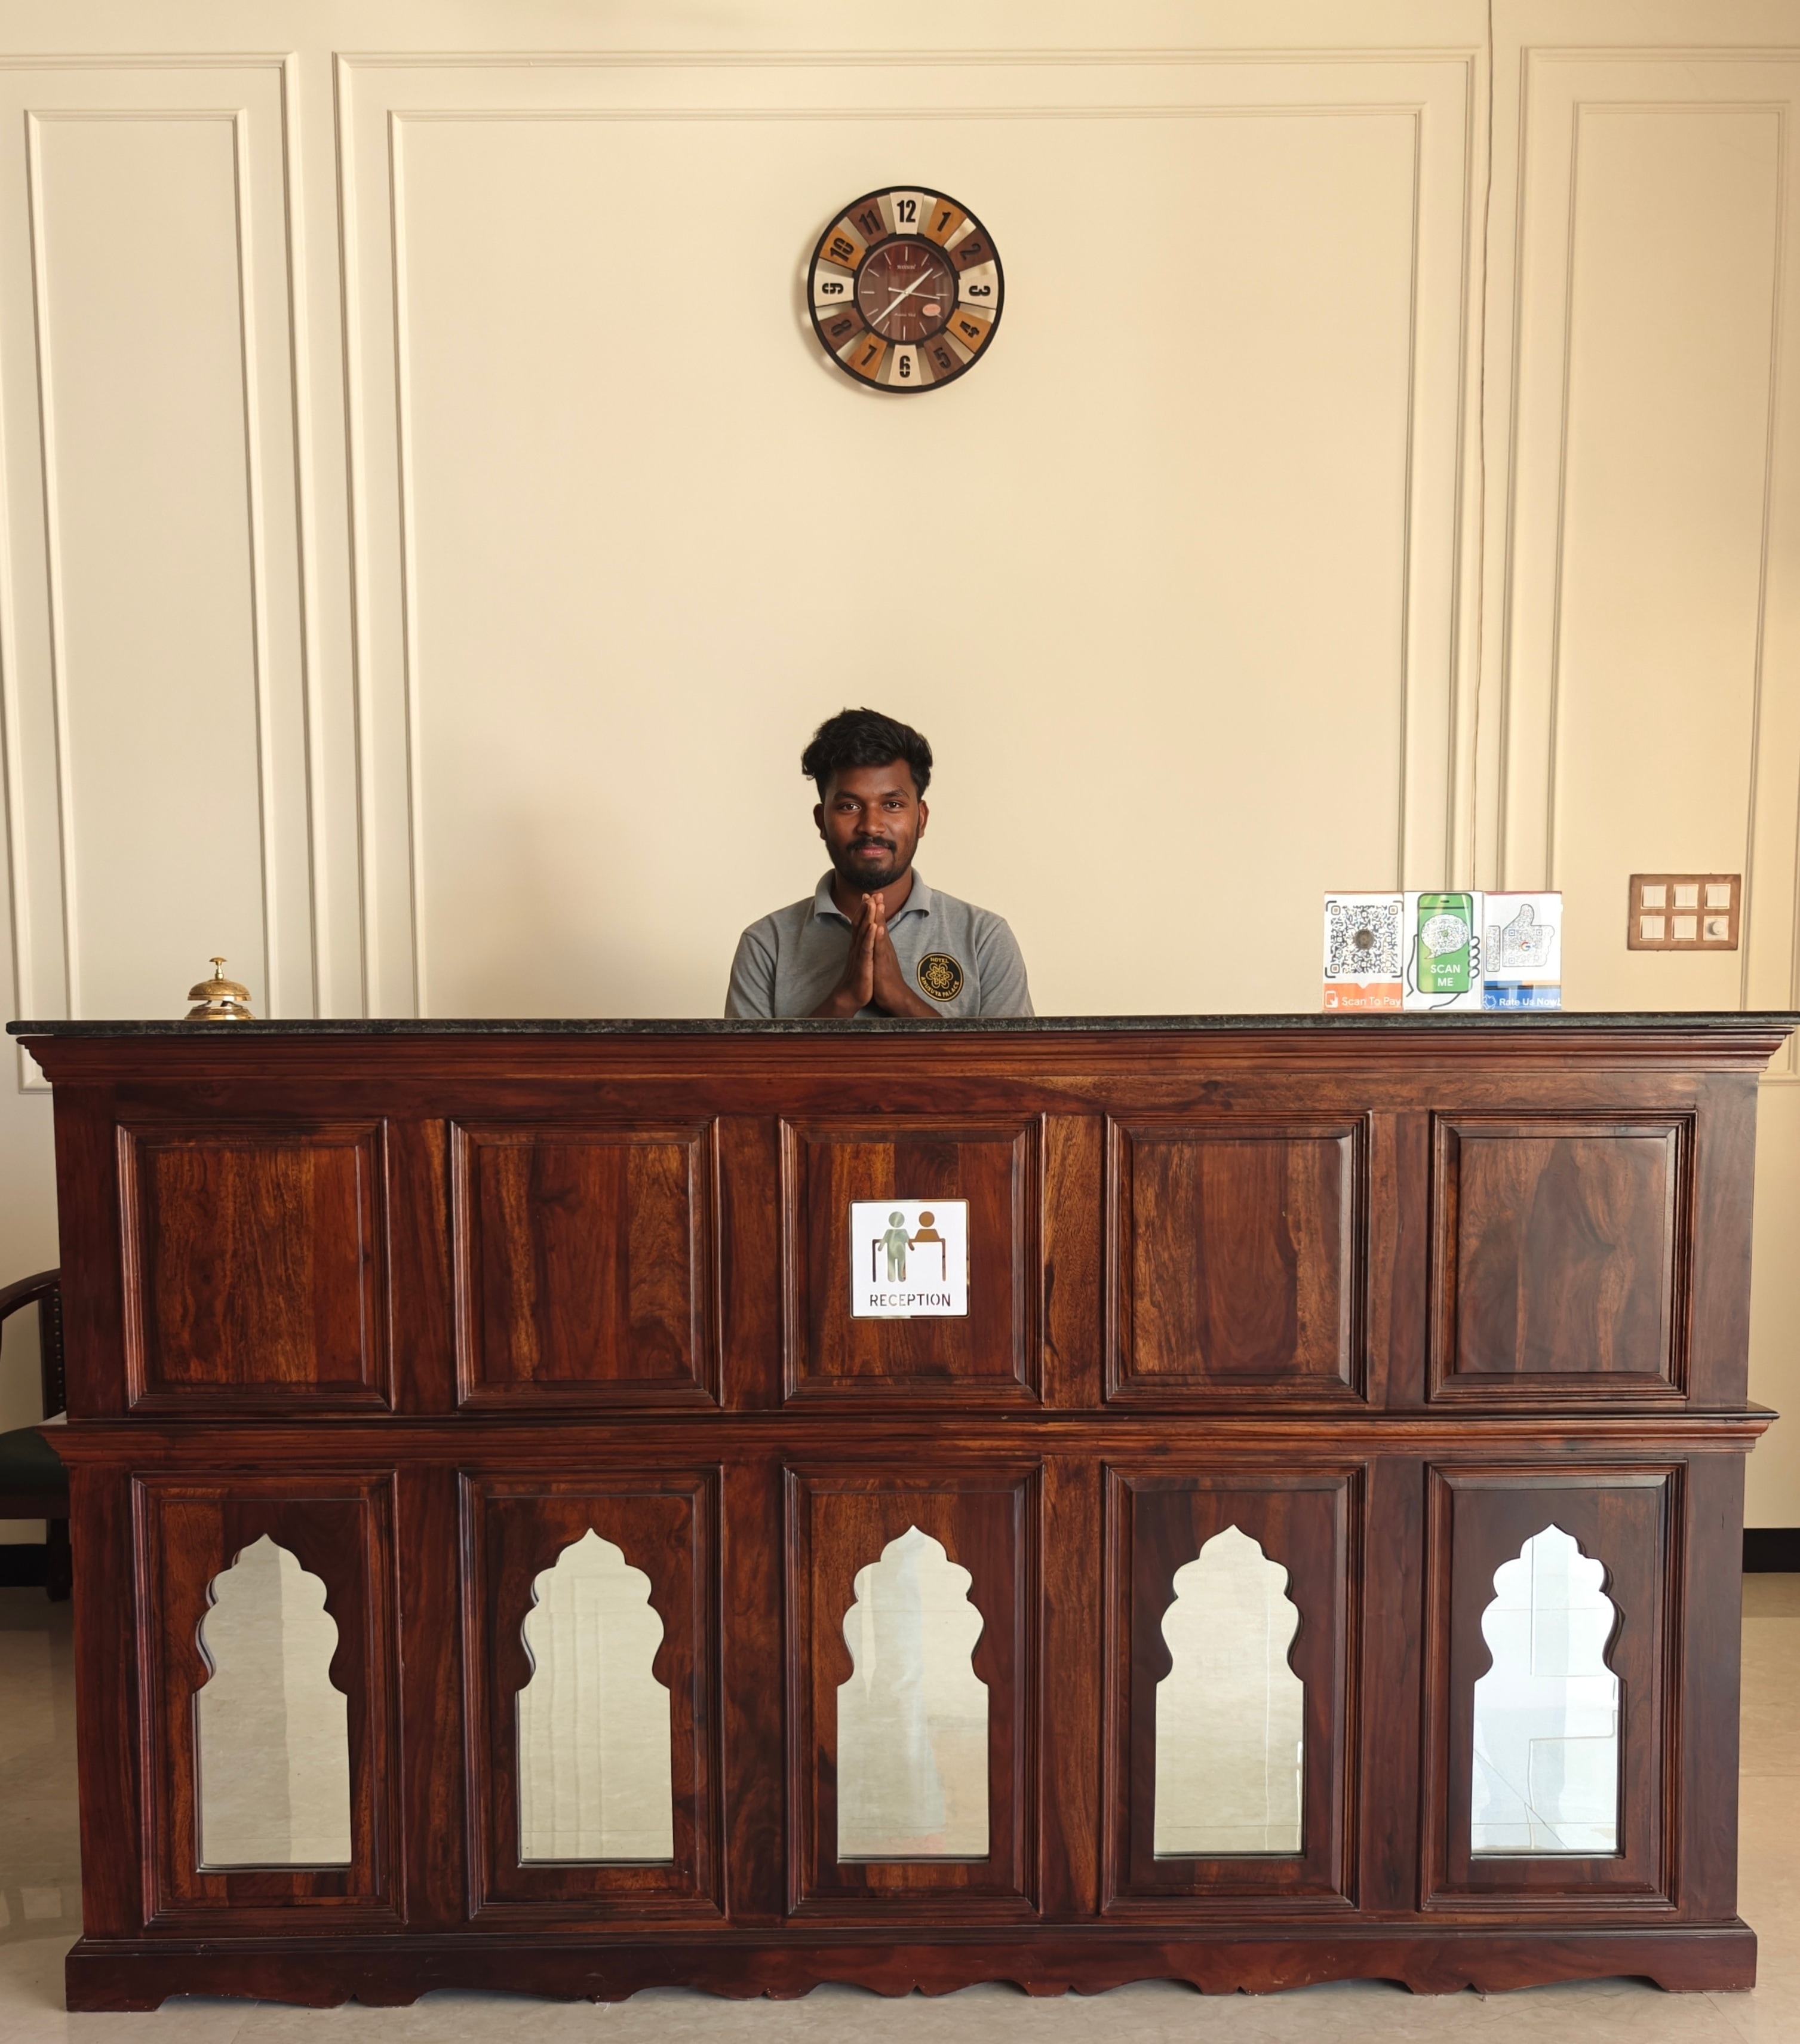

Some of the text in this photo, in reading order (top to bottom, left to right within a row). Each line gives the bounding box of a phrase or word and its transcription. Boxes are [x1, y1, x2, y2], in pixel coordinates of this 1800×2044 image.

[897, 200, 916, 223] 12
[859, 210, 881, 235] 11
[937, 212, 951, 232] 1
[830, 237, 855, 262] 10
[960, 243, 981, 260] 2
[822, 283, 844, 294] 9
[969, 285, 991, 297] 3
[831, 319, 852, 336] 8
[959, 321, 980, 338] 4
[861, 345, 877, 366] 7
[933, 346, 951, 369] 5
[899, 355, 911, 378] 6
[1430, 964, 1460, 974] SCAN
[921, 977, 959, 997] ANUSUYA PALACE
[1437, 977, 1454, 987] ME
[1341, 996, 1401, 1008] Scan To Pay
[1499, 998, 1521, 1006] Rate
[1522, 998, 1534, 1006] Us
[870, 1294, 951, 1306] RECEPTION
